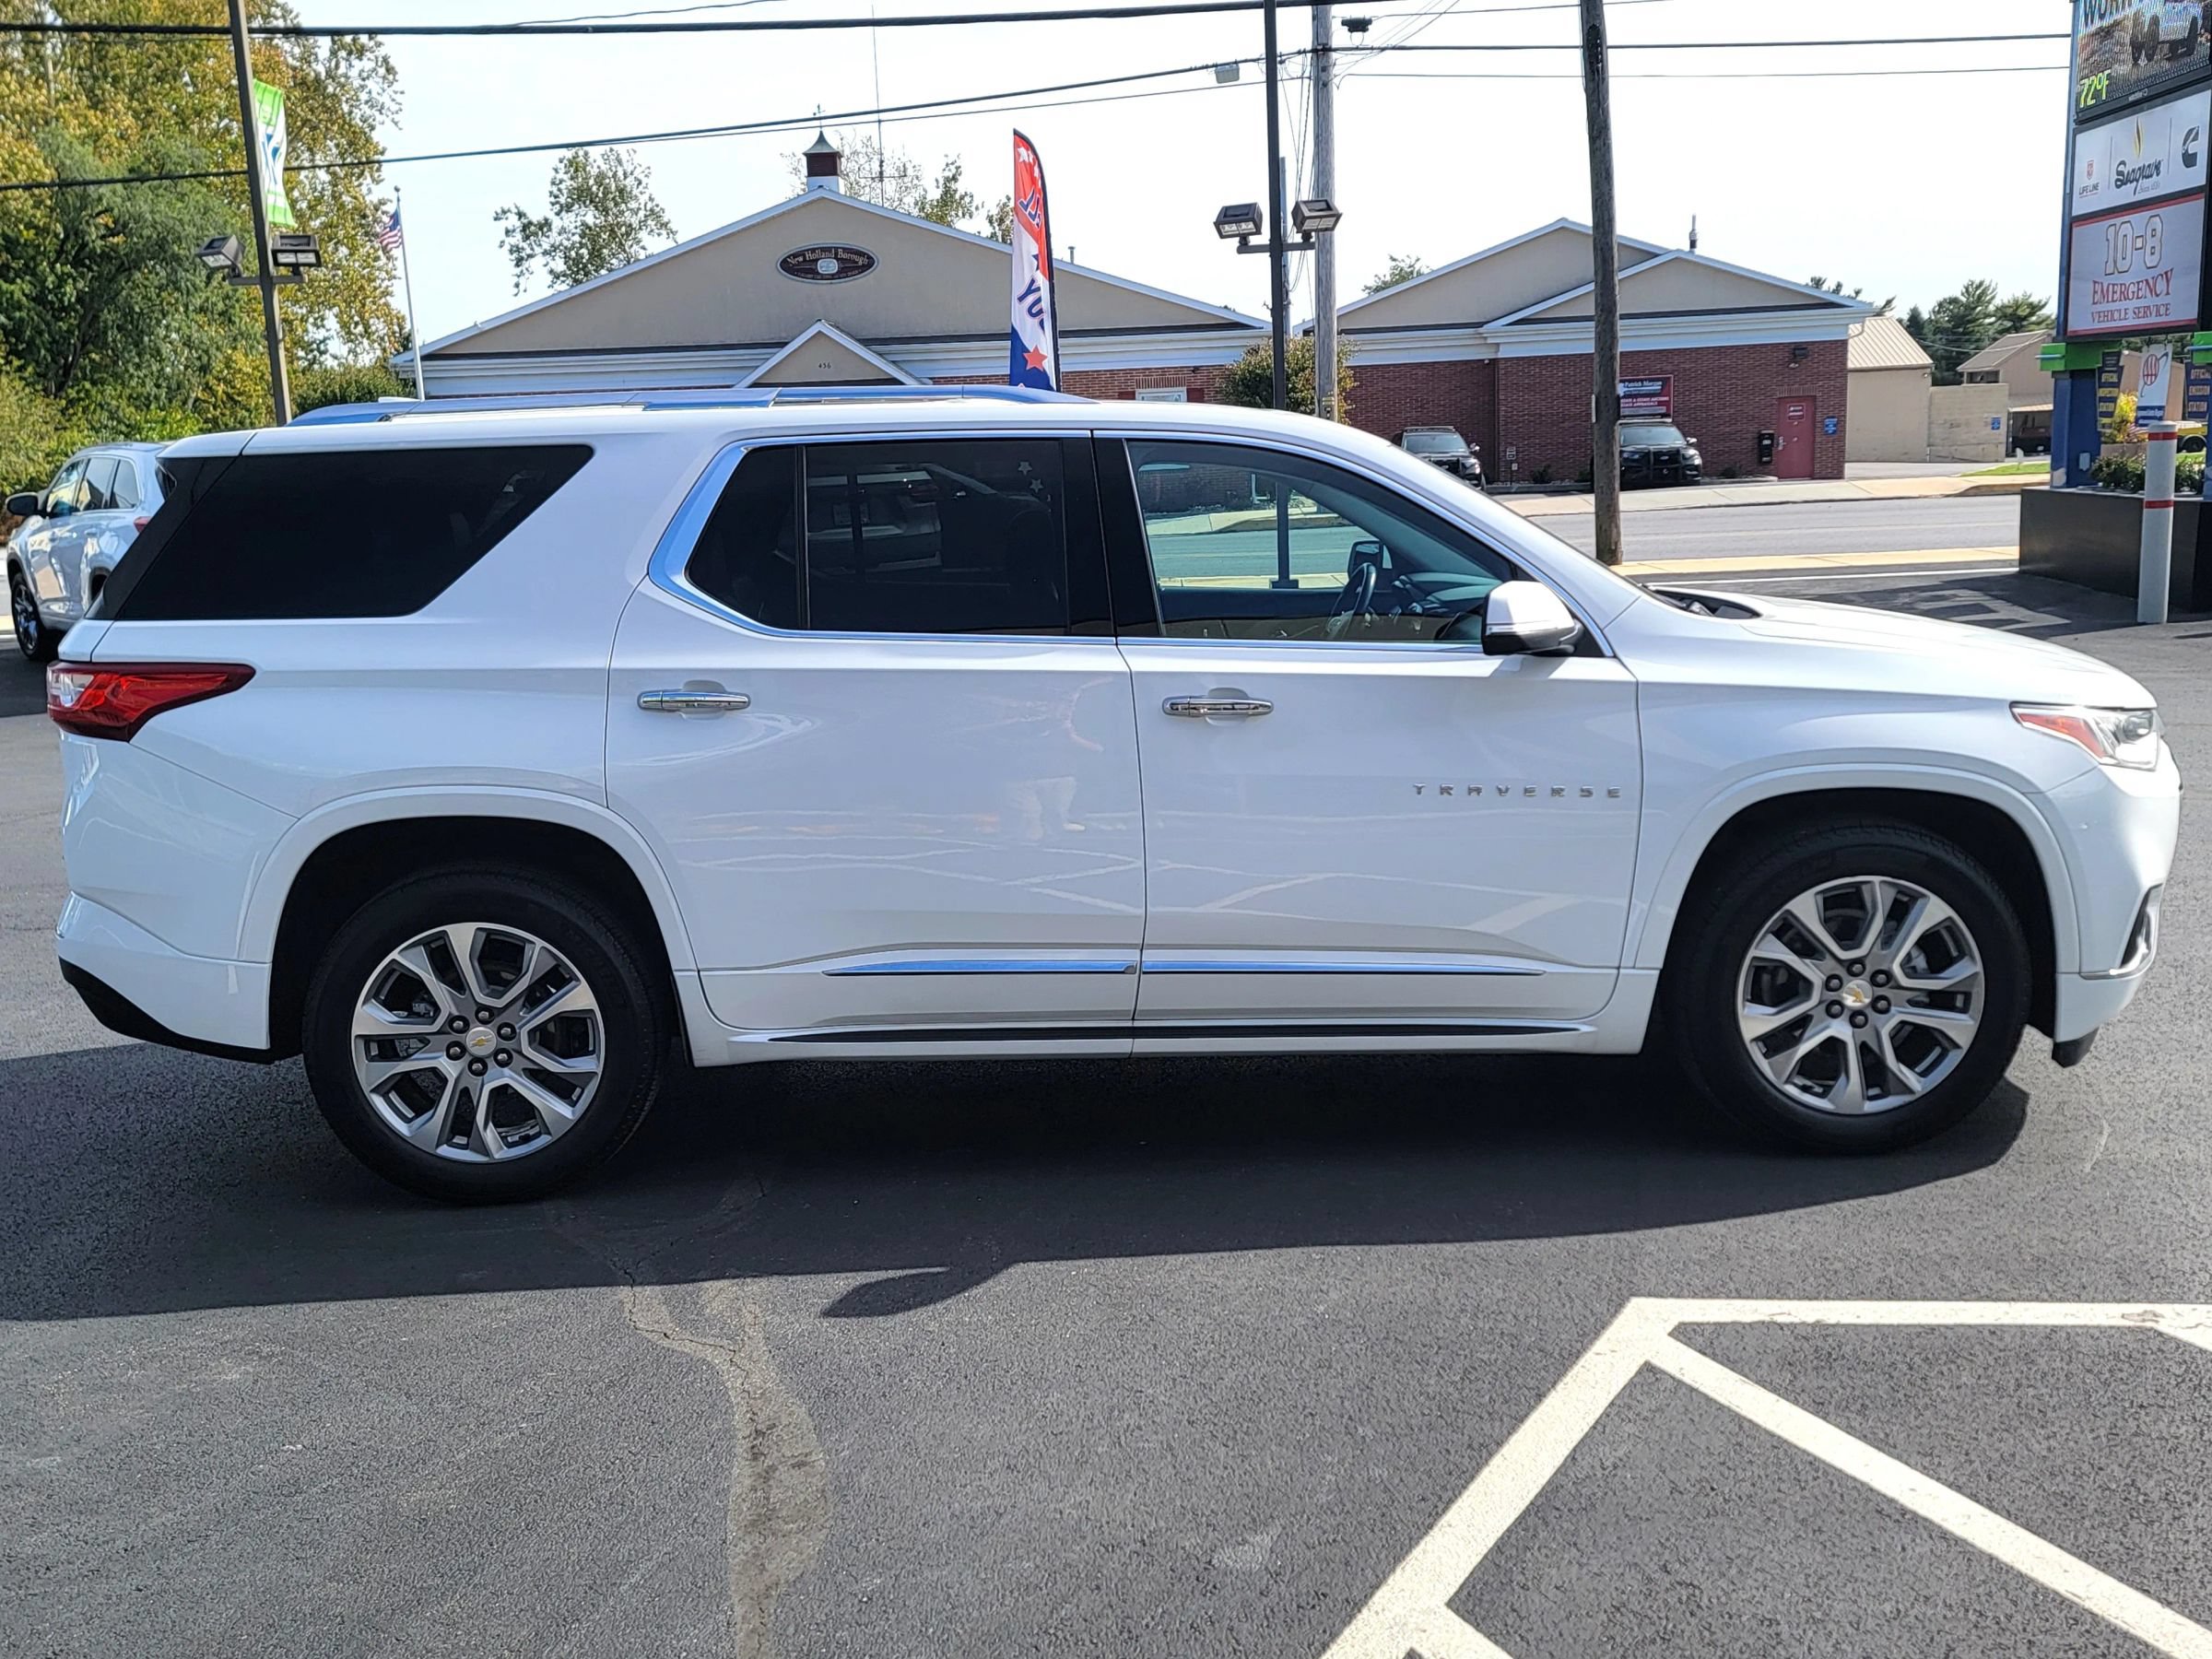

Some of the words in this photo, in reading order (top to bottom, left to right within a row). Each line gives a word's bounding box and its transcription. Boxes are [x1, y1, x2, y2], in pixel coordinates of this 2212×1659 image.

[2114, 159, 2162, 196] Seagrave
[786, 255, 804, 266] New
[805, 248, 835, 261] Holland
[837, 248, 869, 265] Borough
[2104, 214, 2164, 276] 10-8
[2091, 267, 2175, 306] EMERGENCY
[2091, 308, 2130, 324] VEHICLE
[2132, 302, 2171, 320] SERVICE
[1413, 783, 1621, 798] TRAVERSE
